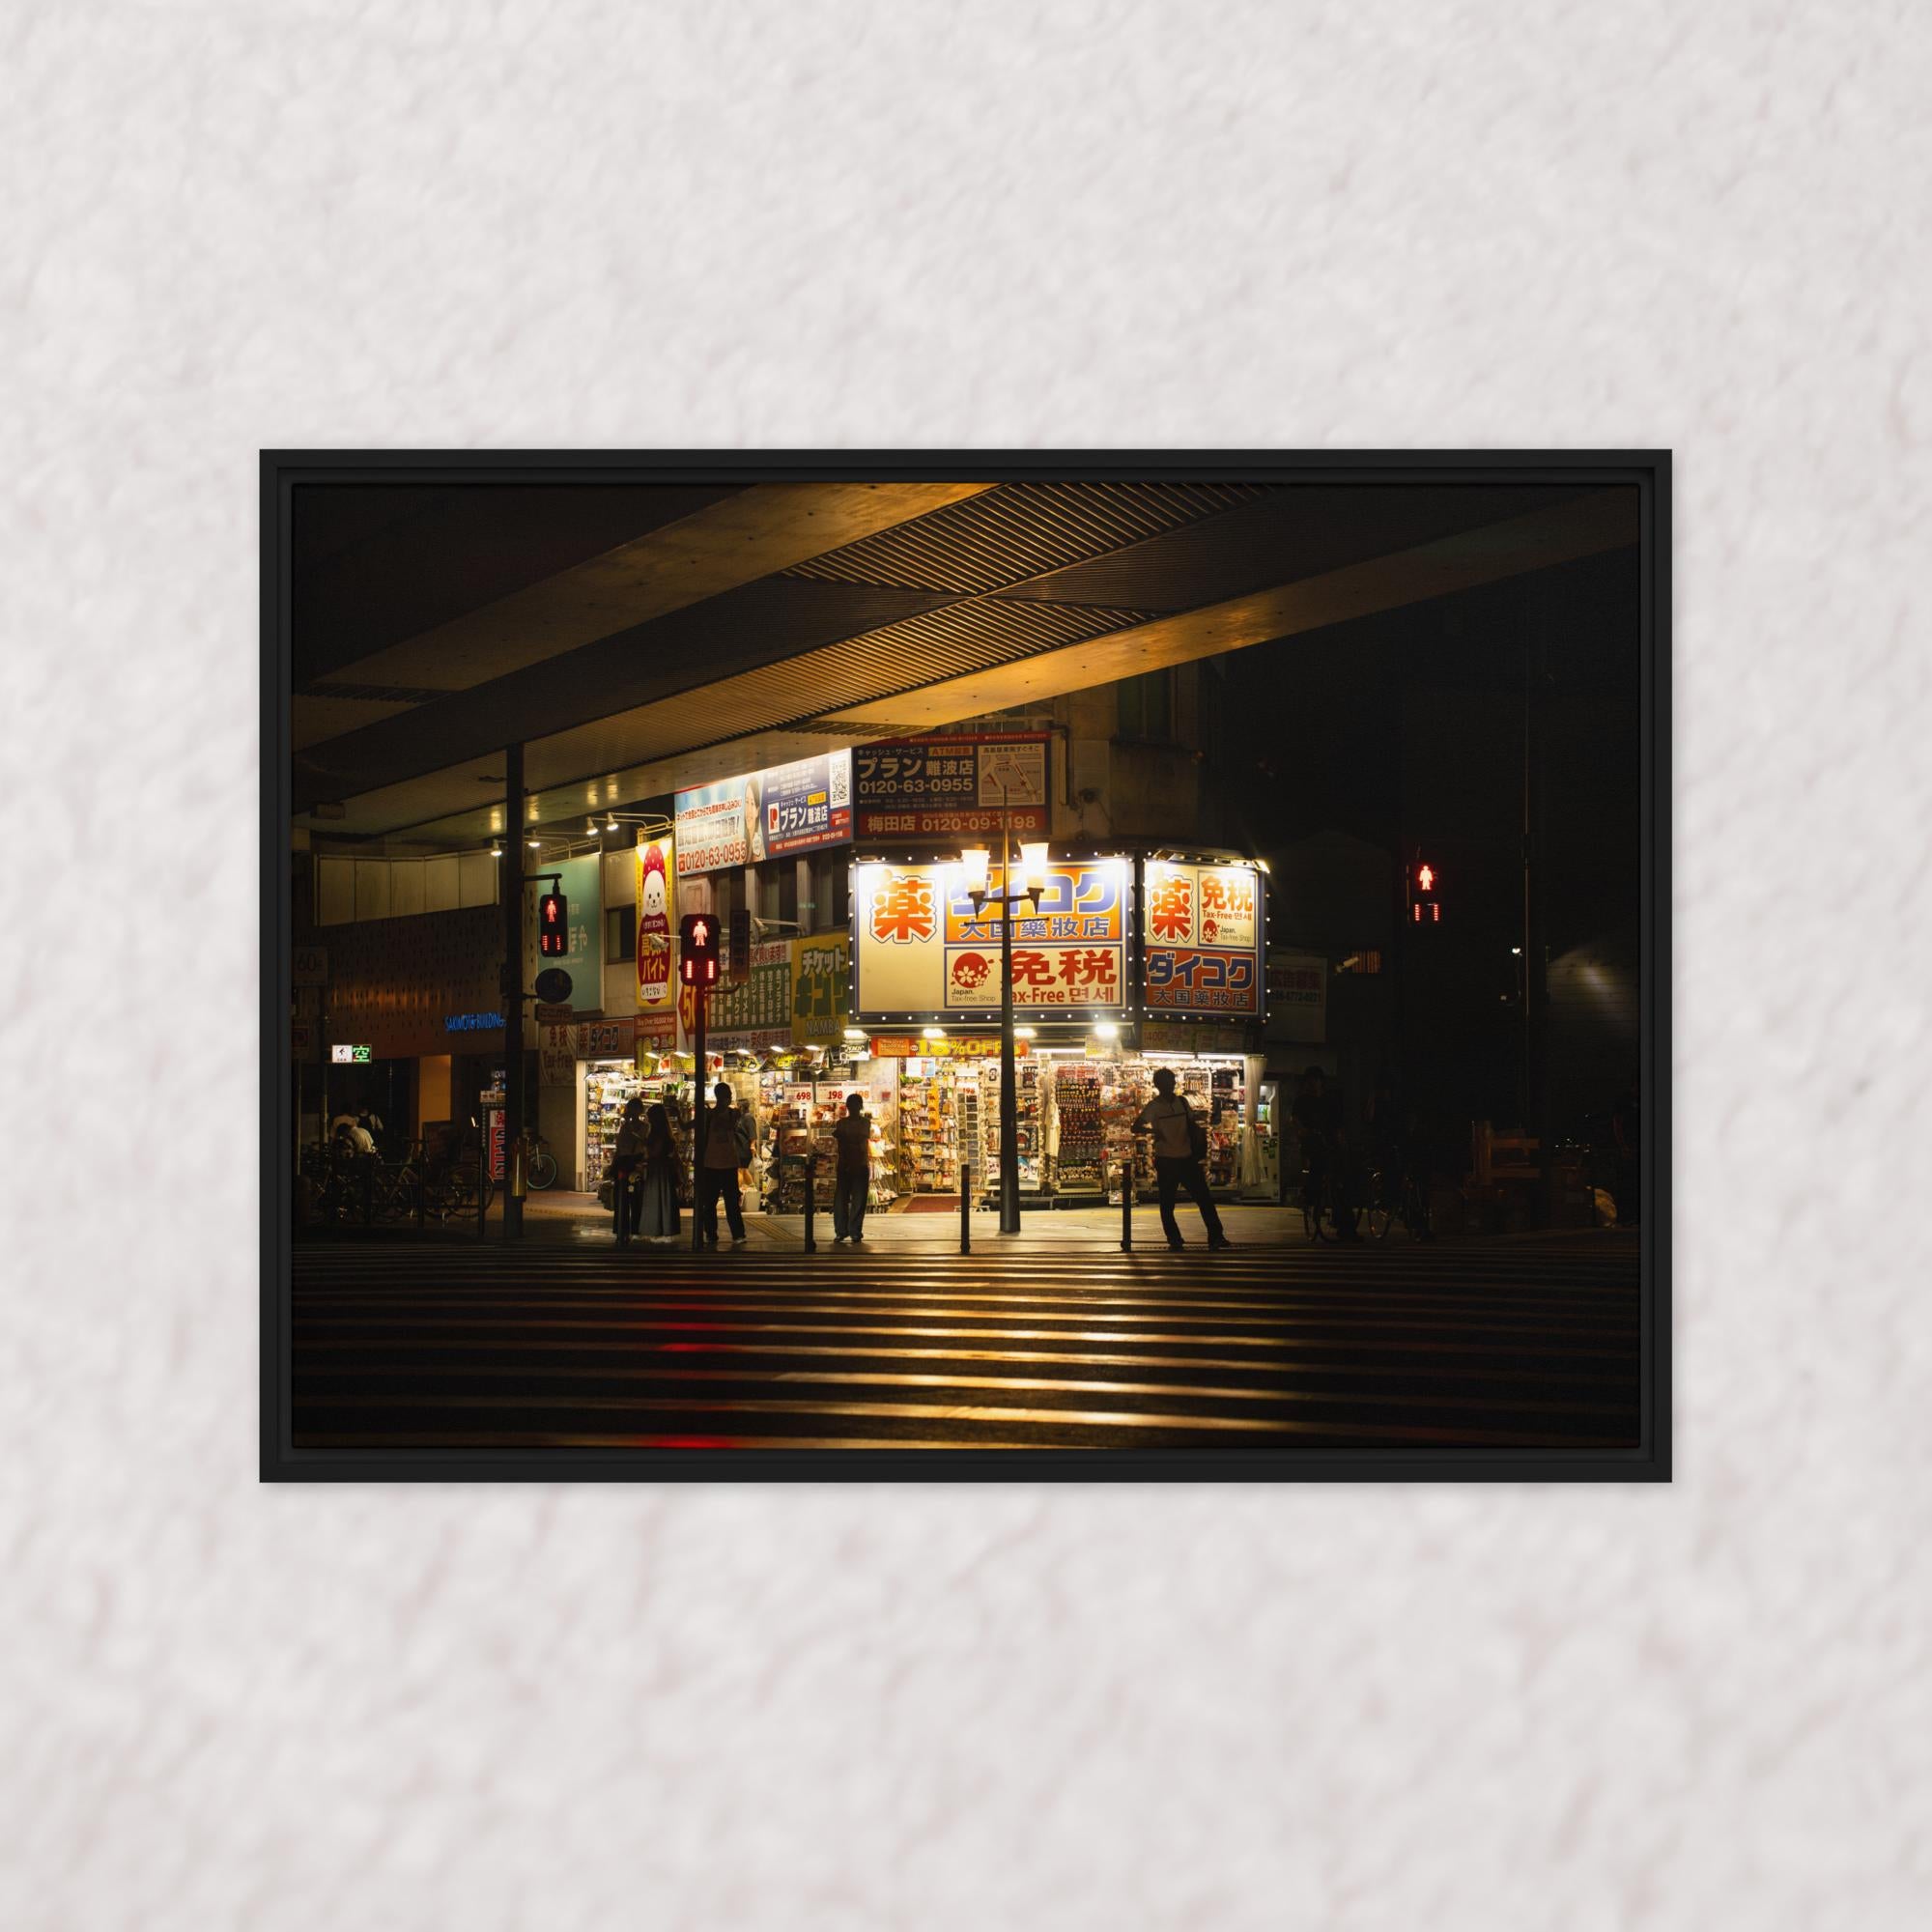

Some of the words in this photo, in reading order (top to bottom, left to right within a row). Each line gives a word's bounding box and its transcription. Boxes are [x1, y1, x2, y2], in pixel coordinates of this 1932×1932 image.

[859, 779, 974, 794] 0120-63-0955
[867, 815, 916, 833] 梅田店
[685, 840, 747, 870] 0120-63-0955
[1201, 875, 1253, 912] 免税
[873, 875, 935, 941] 薬
[1152, 878, 1191, 939] 薬
[642, 956, 666, 981] バイト
[803, 944, 845, 976] チケット
[1000, 949, 1118, 986] 免税
[1148, 952, 1254, 990] ダイコク
[1010, 987, 1065, 1003] ax-Free
[805, 1018, 840, 1037] NAMBA
[796, 1092, 811, 1100] 698
[828, 1091, 842, 1100] 198
